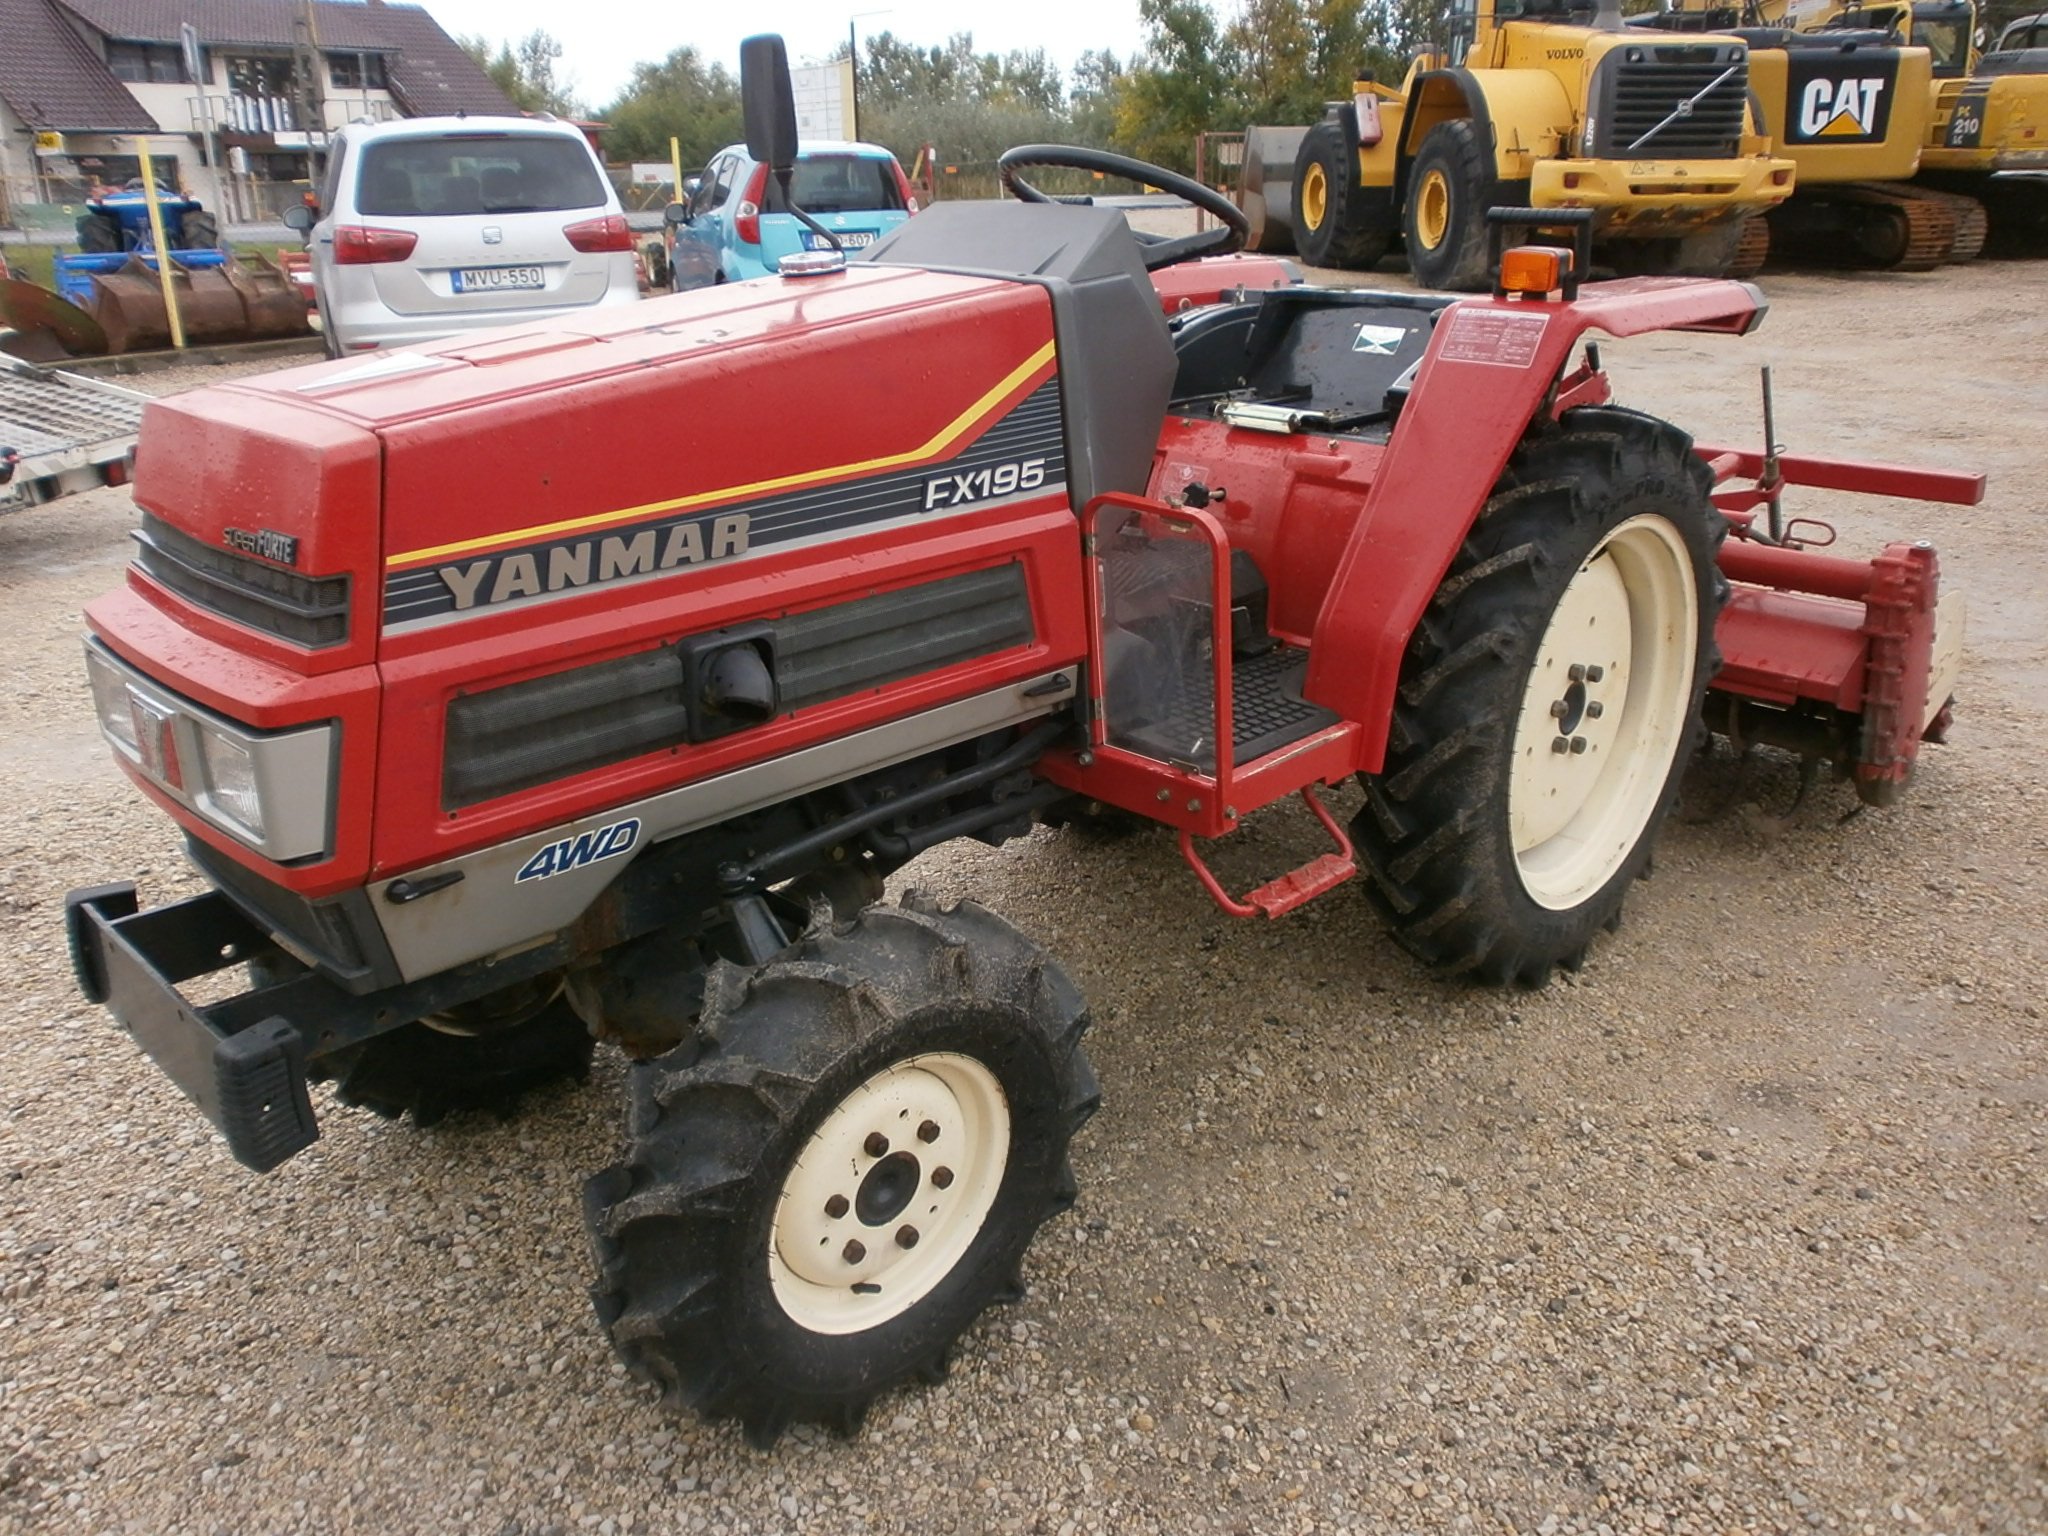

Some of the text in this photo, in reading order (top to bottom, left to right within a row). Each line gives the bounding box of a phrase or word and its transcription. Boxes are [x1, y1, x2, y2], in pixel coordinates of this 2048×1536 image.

[1546, 48, 1584, 60] VOLVO
[1801, 78, 1884, 136] CAT
[1953, 118, 1979, 134] 210
[464, 268, 540, 287] MVU-550
[925, 458, 1046, 509] FX195
[257, 529, 292, 563] FORTE
[439, 513, 750, 611] YANMAR
[514, 817, 641, 884] 4WD
